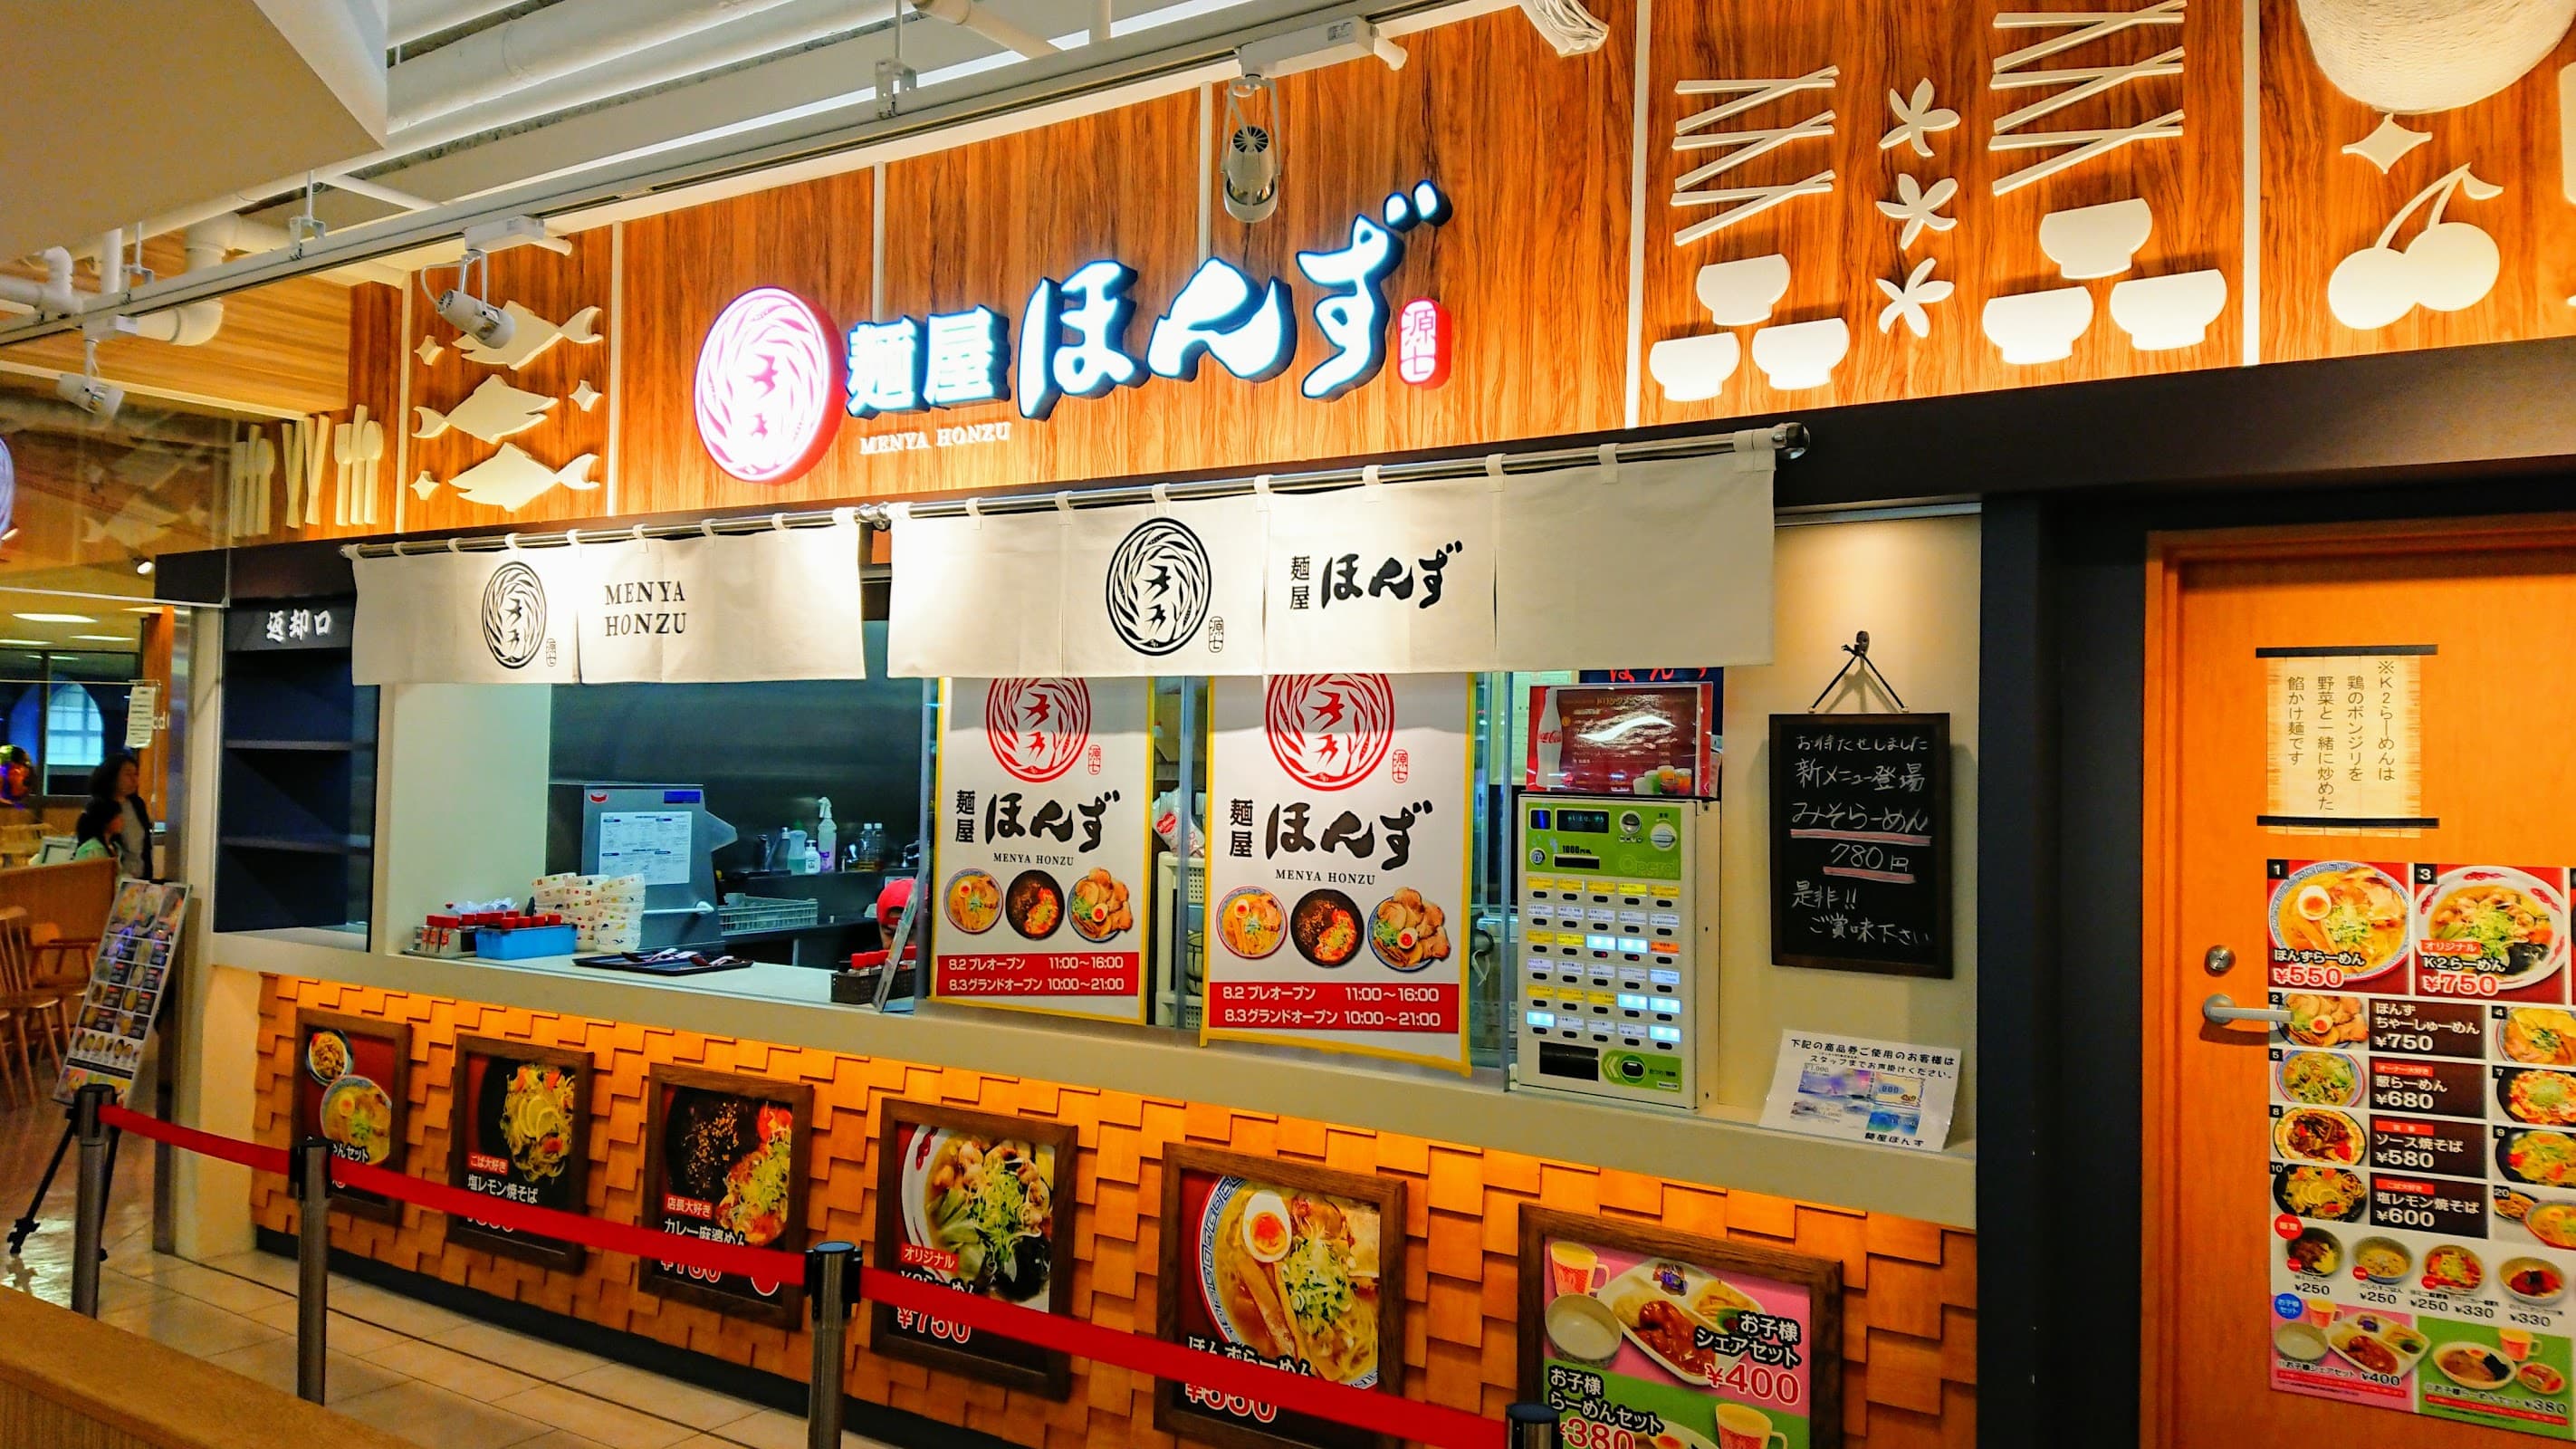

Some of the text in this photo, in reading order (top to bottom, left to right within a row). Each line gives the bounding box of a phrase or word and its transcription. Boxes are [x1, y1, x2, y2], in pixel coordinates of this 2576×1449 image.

[1020, 179, 1452, 420] ほんず
[859, 421, 1011, 455] MENYA HONZU
[1321, 540, 1464, 609] ほんず
[605, 581, 686, 605] MENYA
[266, 609, 332, 643] 返却口
[605, 612, 687, 637] HONZU
[2287, 677, 2304, 765] 餡かけ麺です
[1796, 735, 1928, 751] お待たせしました
[2317, 677, 2334, 811] 野菜と一緒に炒めた
[1795, 758, 1925, 792] 新メニュー登場
[985, 790, 1120, 853] ほんず
[1791, 801, 1929, 833] みそらーめん
[1265, 800, 1433, 870] ほんず
[993, 852, 1074, 866] MENYA HONZU
[1831, 843, 1909, 872] 780円
[1275, 869, 1376, 885] MENYA HONZU
[2274, 864, 2281, 874] 1
[2418, 868, 2431, 880] 3
[1810, 913, 1930, 945] ご賞味下さい
[2274, 949, 2366, 966] ほんずらーめん
[2424, 942, 2477, 953] オリジナル
[2422, 956, 2508, 973] K2らーめん
[2274, 964, 2344, 988] ¥550
[2423, 974, 2499, 996] ¥750
[2271, 993, 2279, 1003] 2
[2375, 1003, 2416, 1016] ほんず
[2375, 1016, 2480, 1035] ちゃーしゅーめん
[2376, 1033, 2434, 1051] ¥750
[2272, 1051, 2279, 1060] 5
[2376, 1092, 2434, 1109] ¥680
[2376, 1134, 2464, 1153] ソース焼そば
[2376, 1150, 2435, 1168] ¥580
[467, 1174, 539, 1204] 塩レモン焼そば
[666, 1197, 711, 1217] 店長大好き
[2376, 1192, 2480, 1214] 塩レモン焼そば
[2376, 1208, 2436, 1227] ¥600
[904, 1247, 956, 1269] オリジナル
[2294, 1283, 2331, 1295] ¥250
[2360, 1291, 2397, 1304] ¥250
[2410, 1299, 2448, 1311] ¥250
[2455, 1306, 2495, 1318] ¥330
[1740, 1313, 1798, 1343] お子様
[2510, 1314, 2551, 1327] ¥330
[1695, 1329, 1798, 1367] シェアセット
[1550, 1368, 1602, 1396] お子様
[1707, 1362, 1800, 1405] ¥400
[2361, 1373, 2400, 1386] ¥400
[1549, 1391, 1662, 1434] らーめんセット
